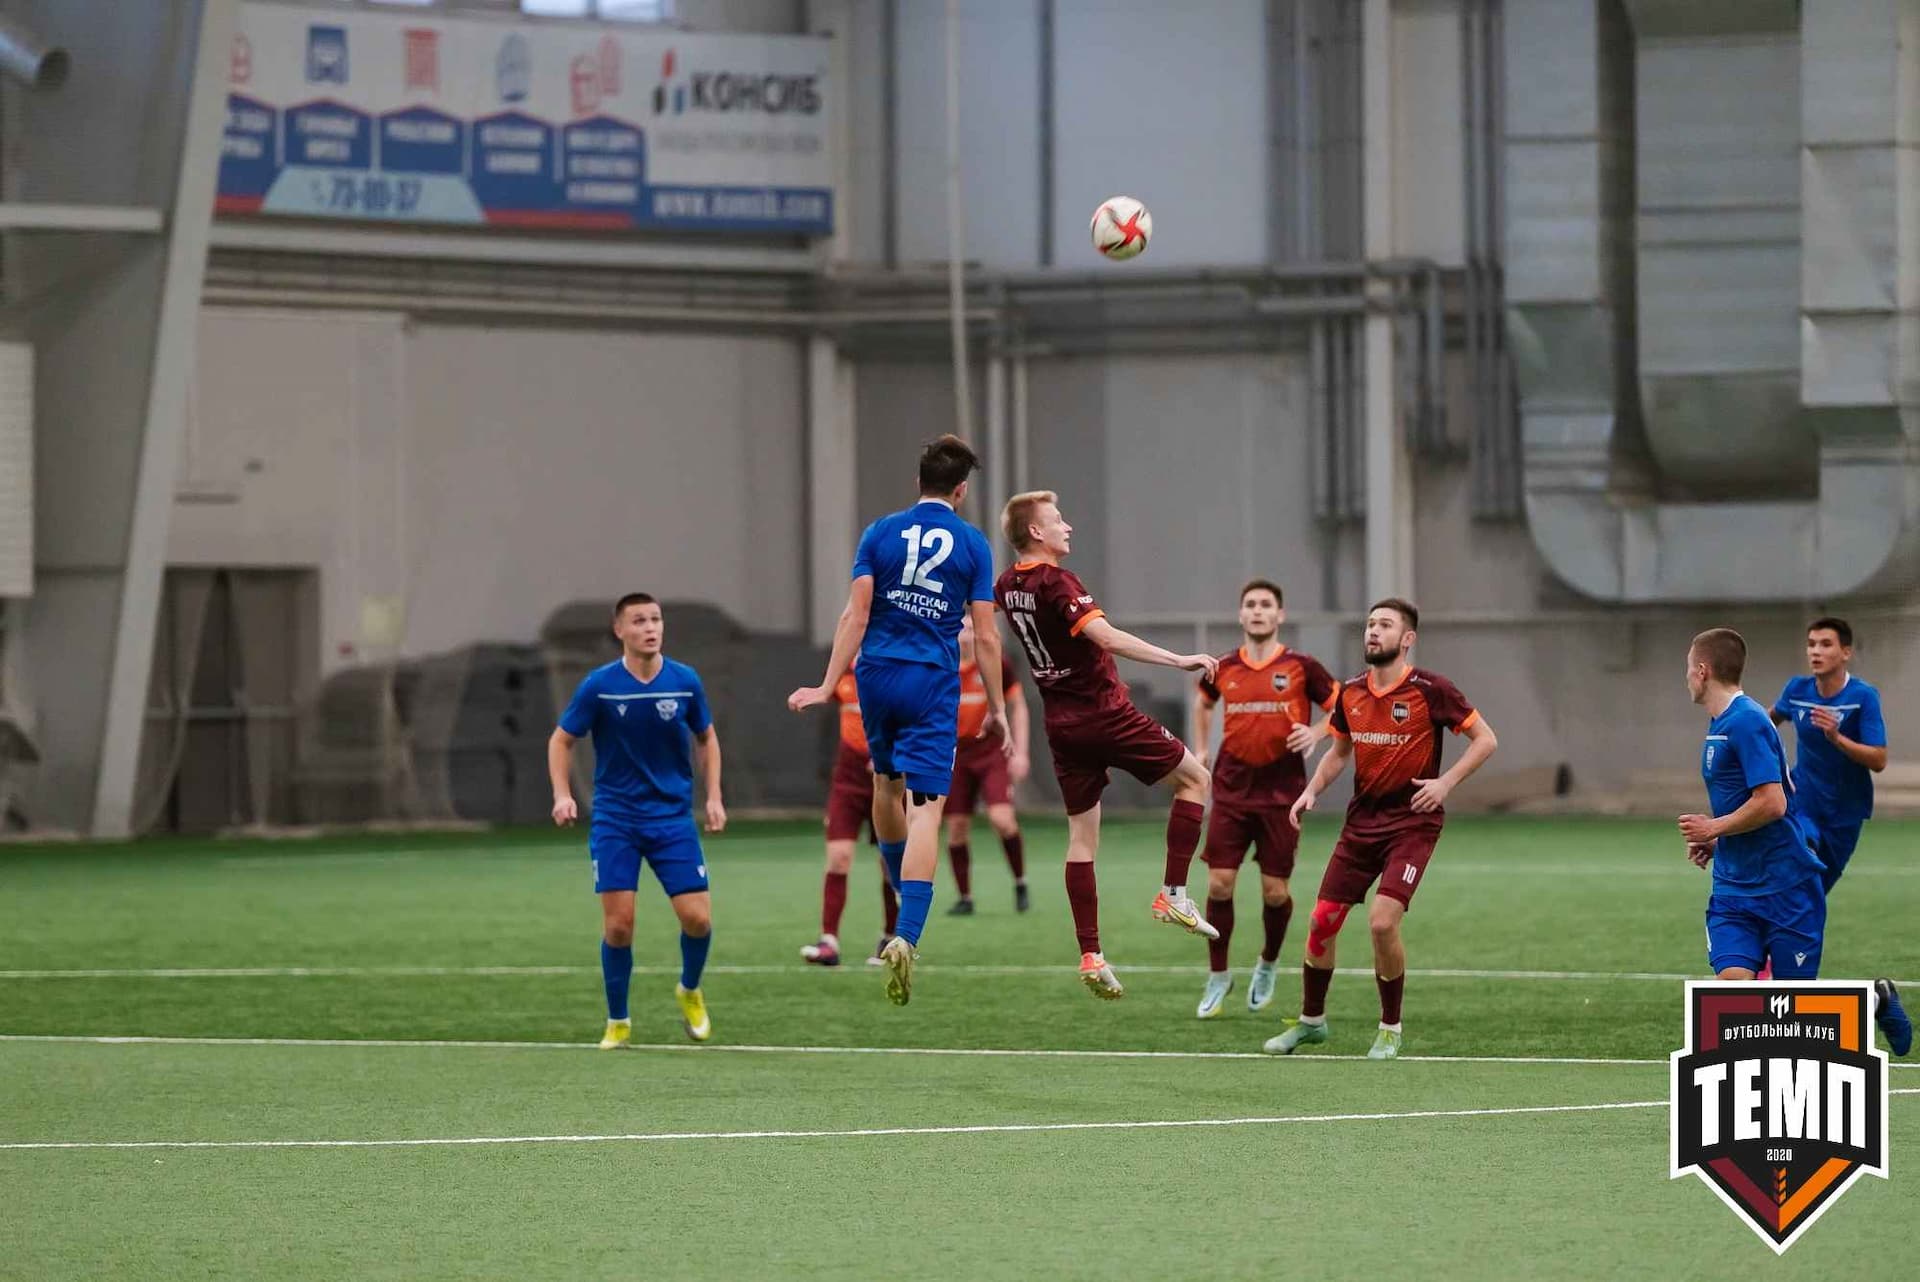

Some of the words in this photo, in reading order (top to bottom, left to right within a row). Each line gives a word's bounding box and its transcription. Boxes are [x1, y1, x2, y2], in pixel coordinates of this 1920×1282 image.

[691, 71, 822, 115] КОНСИБ
[901, 524, 955, 593] 12
[891, 600, 941, 620] ЛАСТЬ
[1402, 863, 1417, 884] 10
